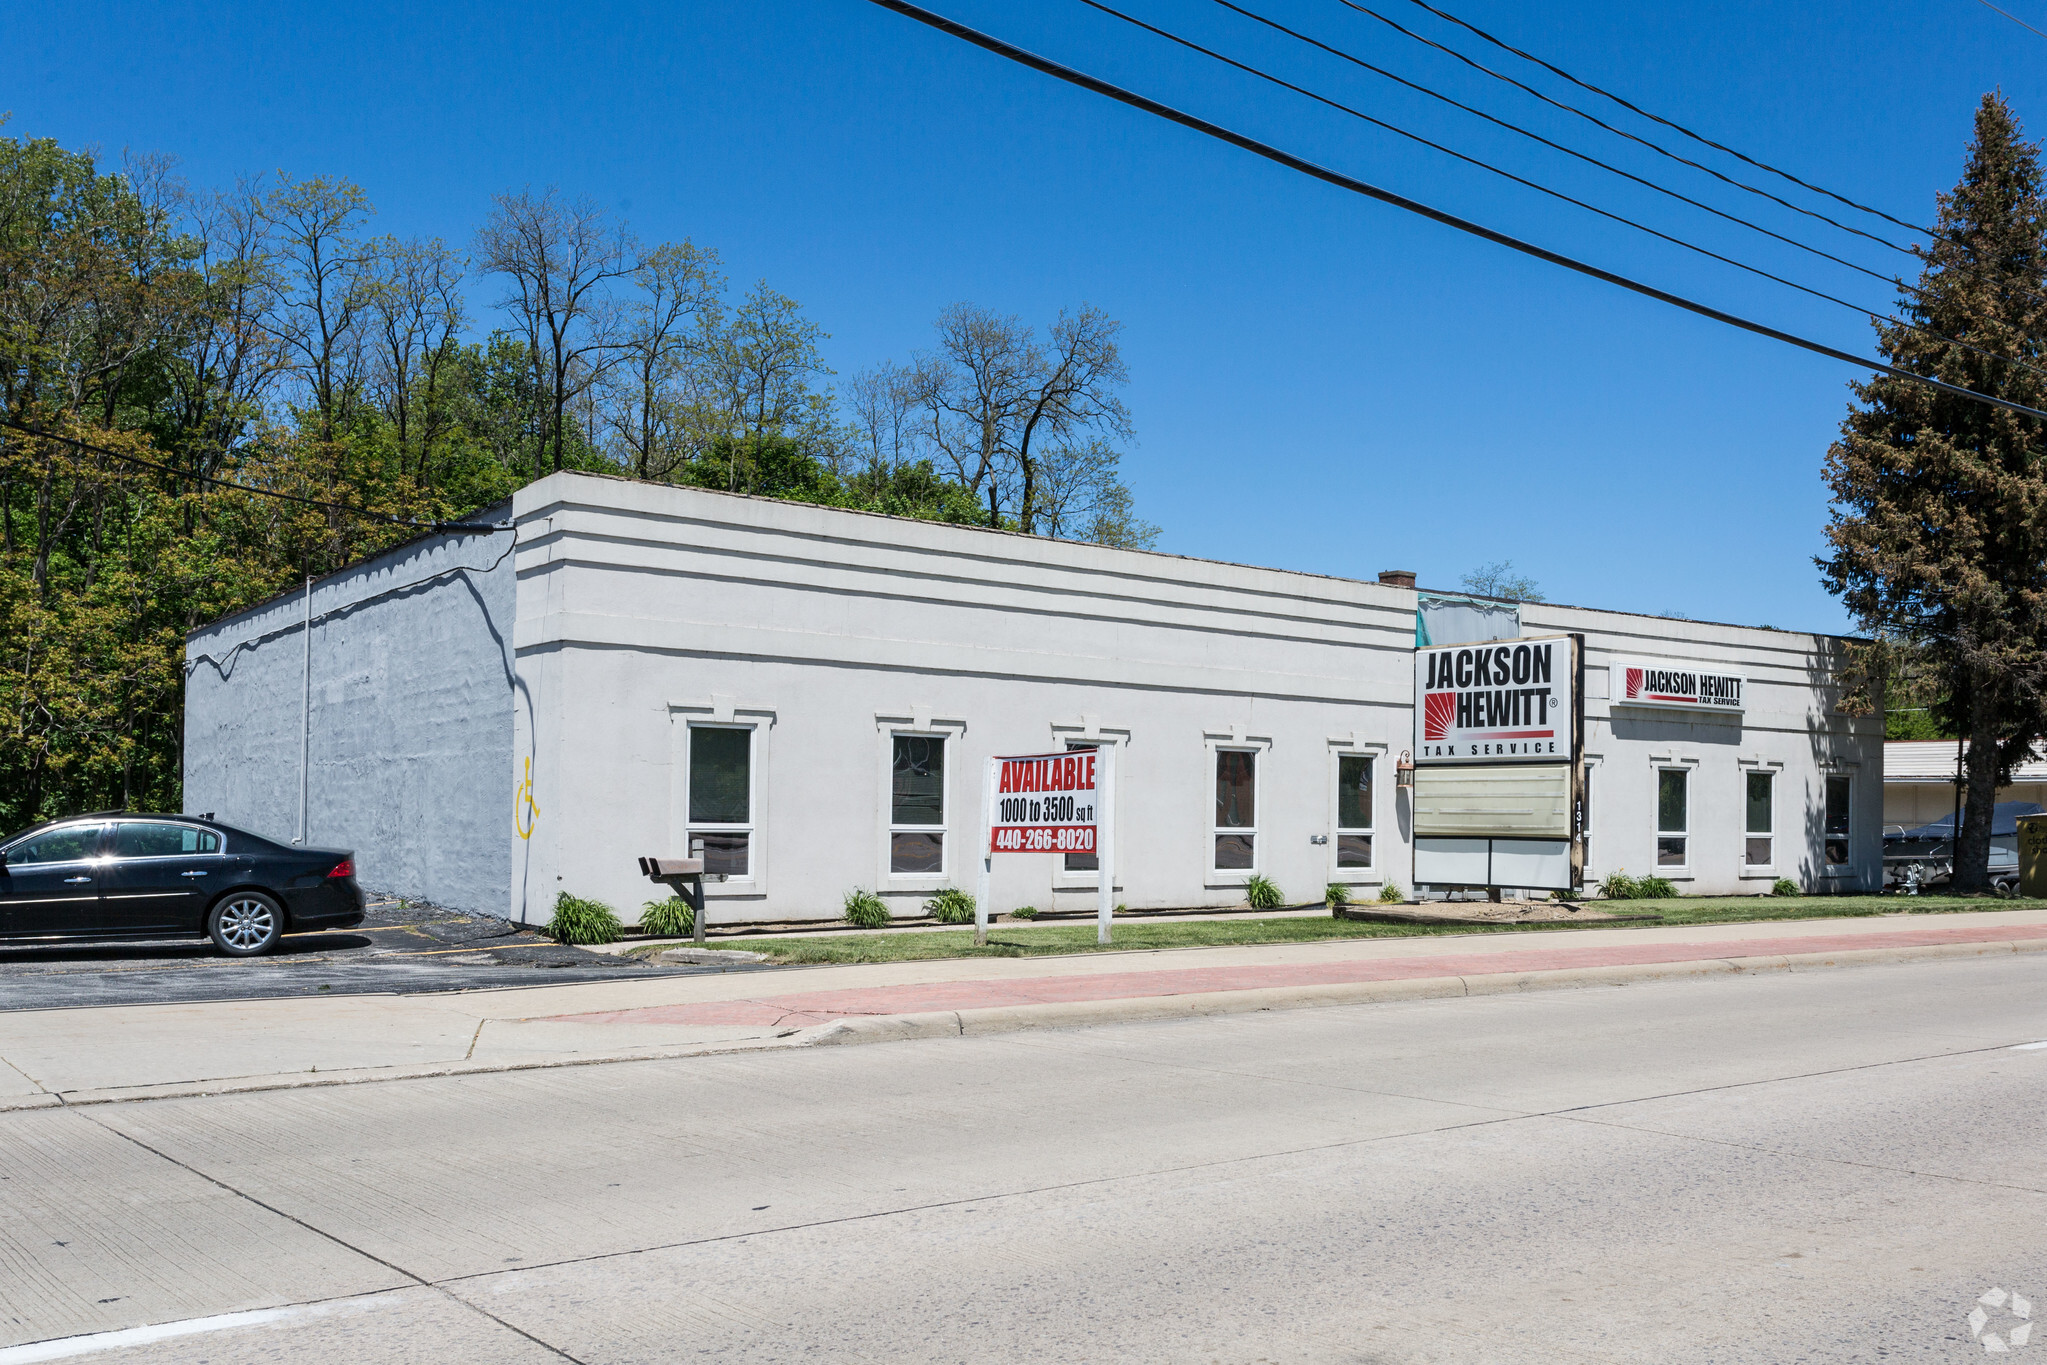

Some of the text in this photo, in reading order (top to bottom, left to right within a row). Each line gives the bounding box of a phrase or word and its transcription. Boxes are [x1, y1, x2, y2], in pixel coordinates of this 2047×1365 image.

[1425, 644, 1552, 690] JACKSON
[1644, 670, 1741, 698] JACKSON HEWITT
[1456, 688, 1552, 728] HEWITT
[1699, 696, 1741, 706] TAX SERVICE
[1424, 742, 1555, 757] TAX SERVICE
[998, 756, 1096, 793] AVAILABLE
[999, 795, 1093, 823] 1000 to 3500 sq ft
[1575, 800, 1583, 844] 1314
[996, 828, 1094, 851] 440-266-8020
